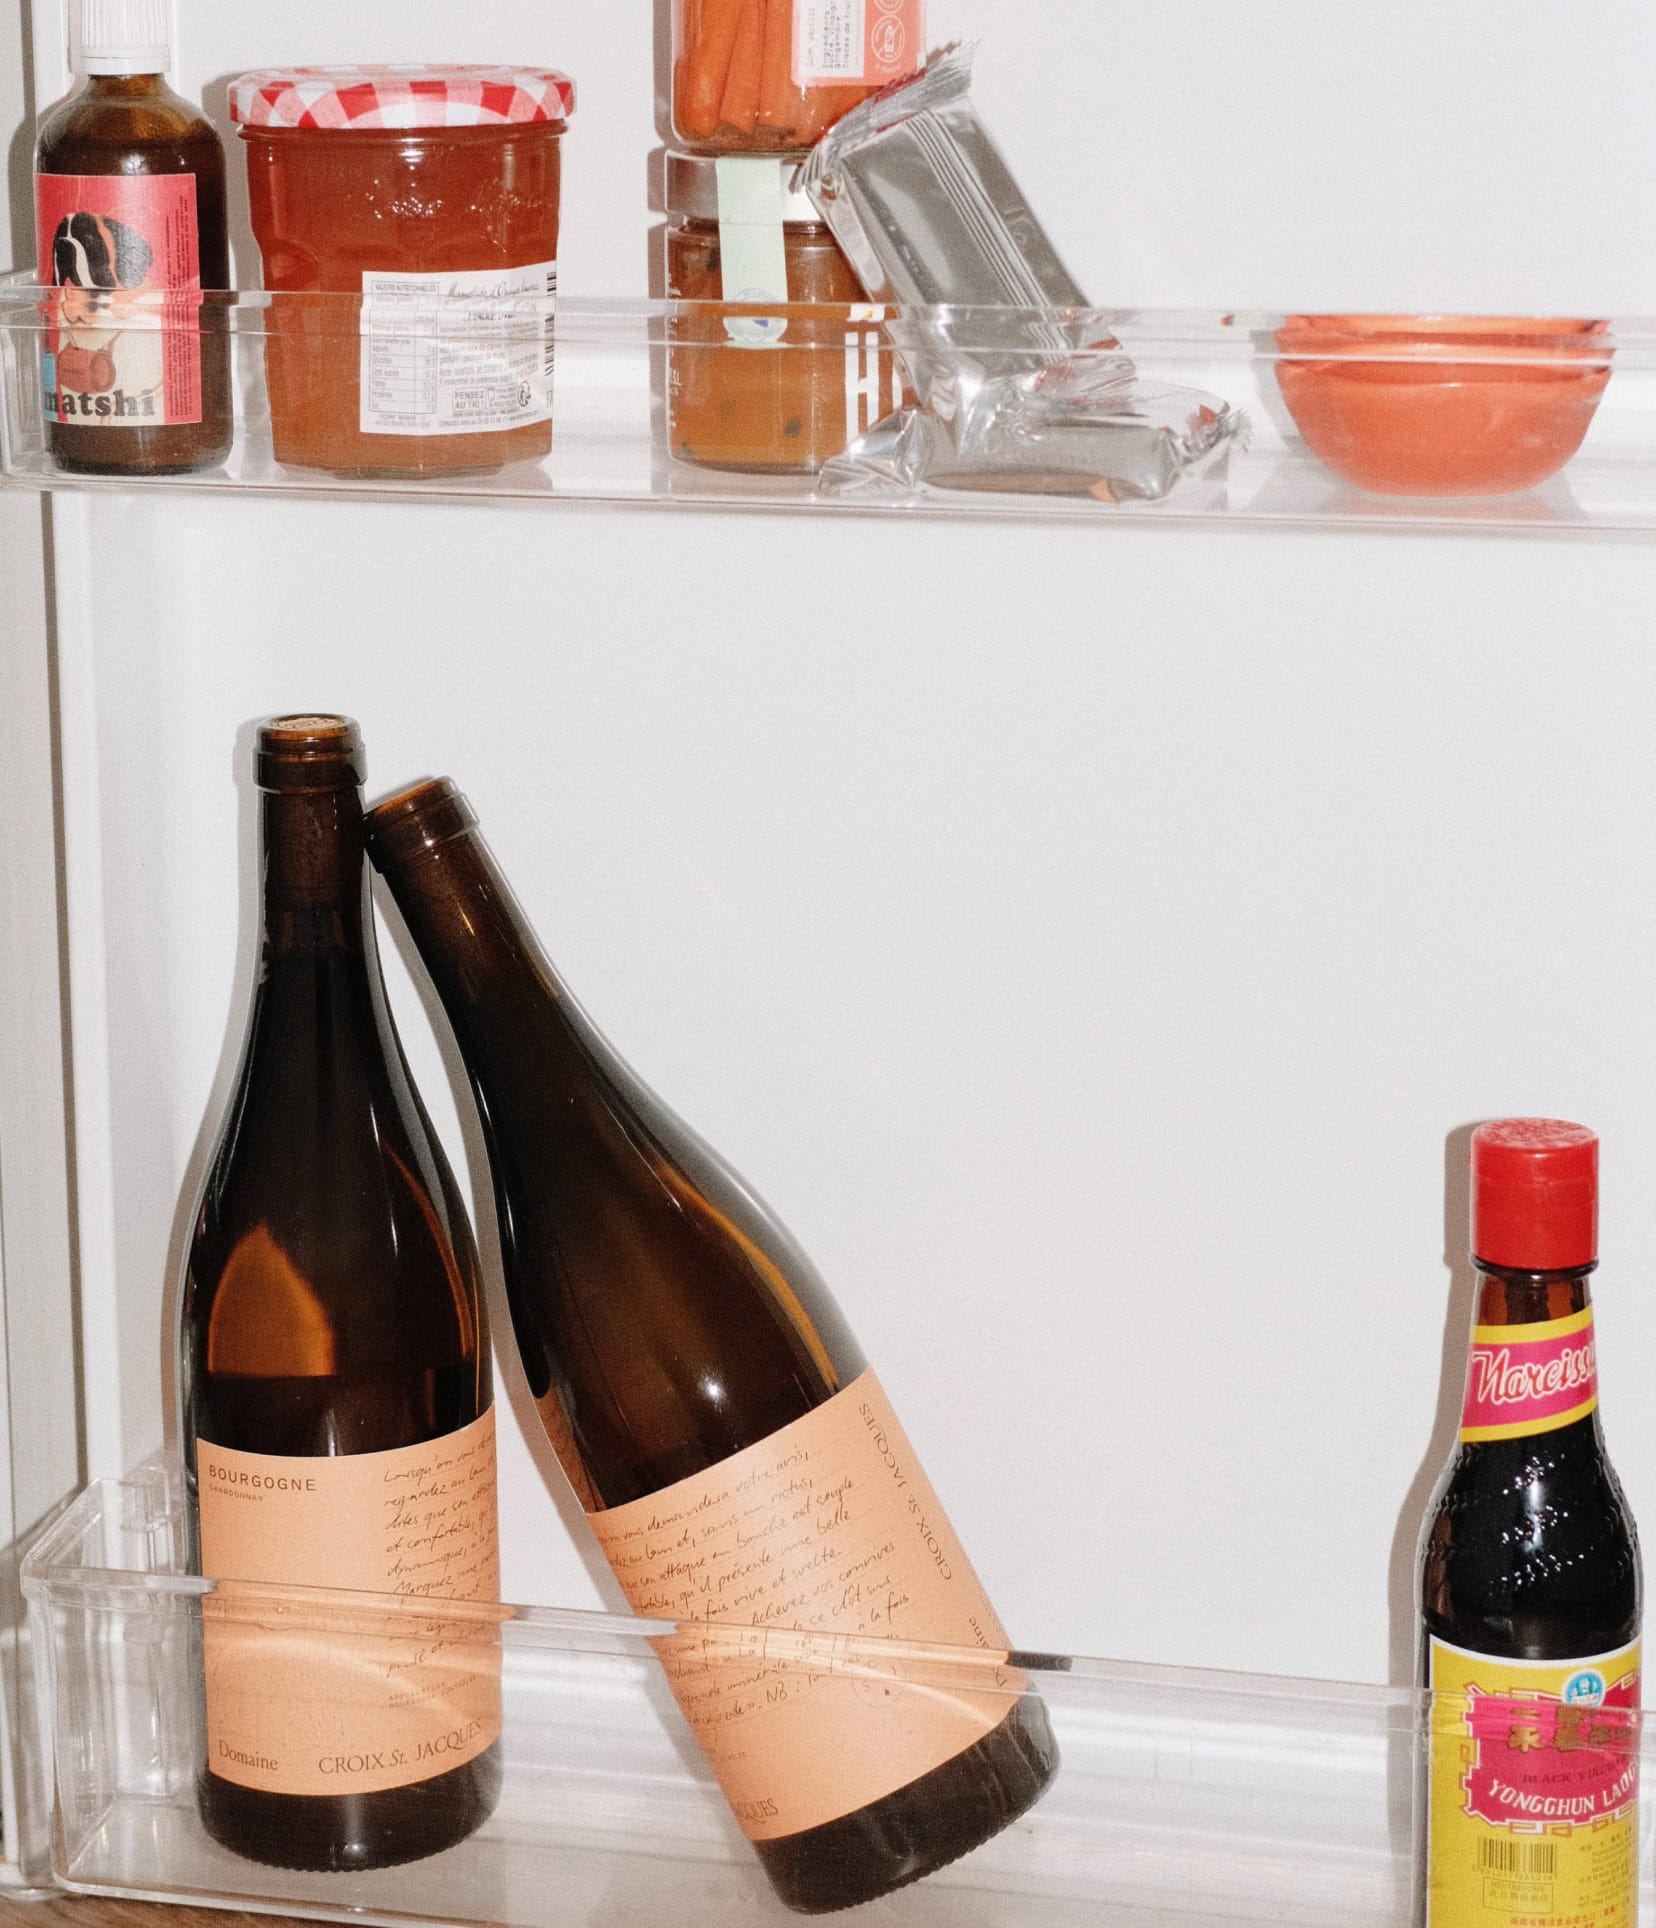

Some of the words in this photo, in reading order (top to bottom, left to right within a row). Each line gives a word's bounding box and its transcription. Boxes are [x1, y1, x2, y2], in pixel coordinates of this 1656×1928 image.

[455, 391, 485, 400] PENSEZ
[858, 1402, 908, 1489] JACQUES
[209, 1464, 316, 1491] BOURGOGNE
[209, 1484, 264, 1501] CHARDONNAY
[908, 1493, 921, 1514] St.
[816, 1502, 851, 1536] belle
[838, 1541, 896, 1582] convives
[916, 1516, 952, 1581] CROIX
[660, 1558, 706, 1582] attaque
[886, 1591, 910, 1624] fois
[218, 1739, 279, 1772] Domaine
[318, 1752, 386, 1775] CROIX
[388, 1748, 408, 1768] St.
[413, 1716, 483, 1762] JACQUES
[1523, 1773, 1570, 1784] BLACK
